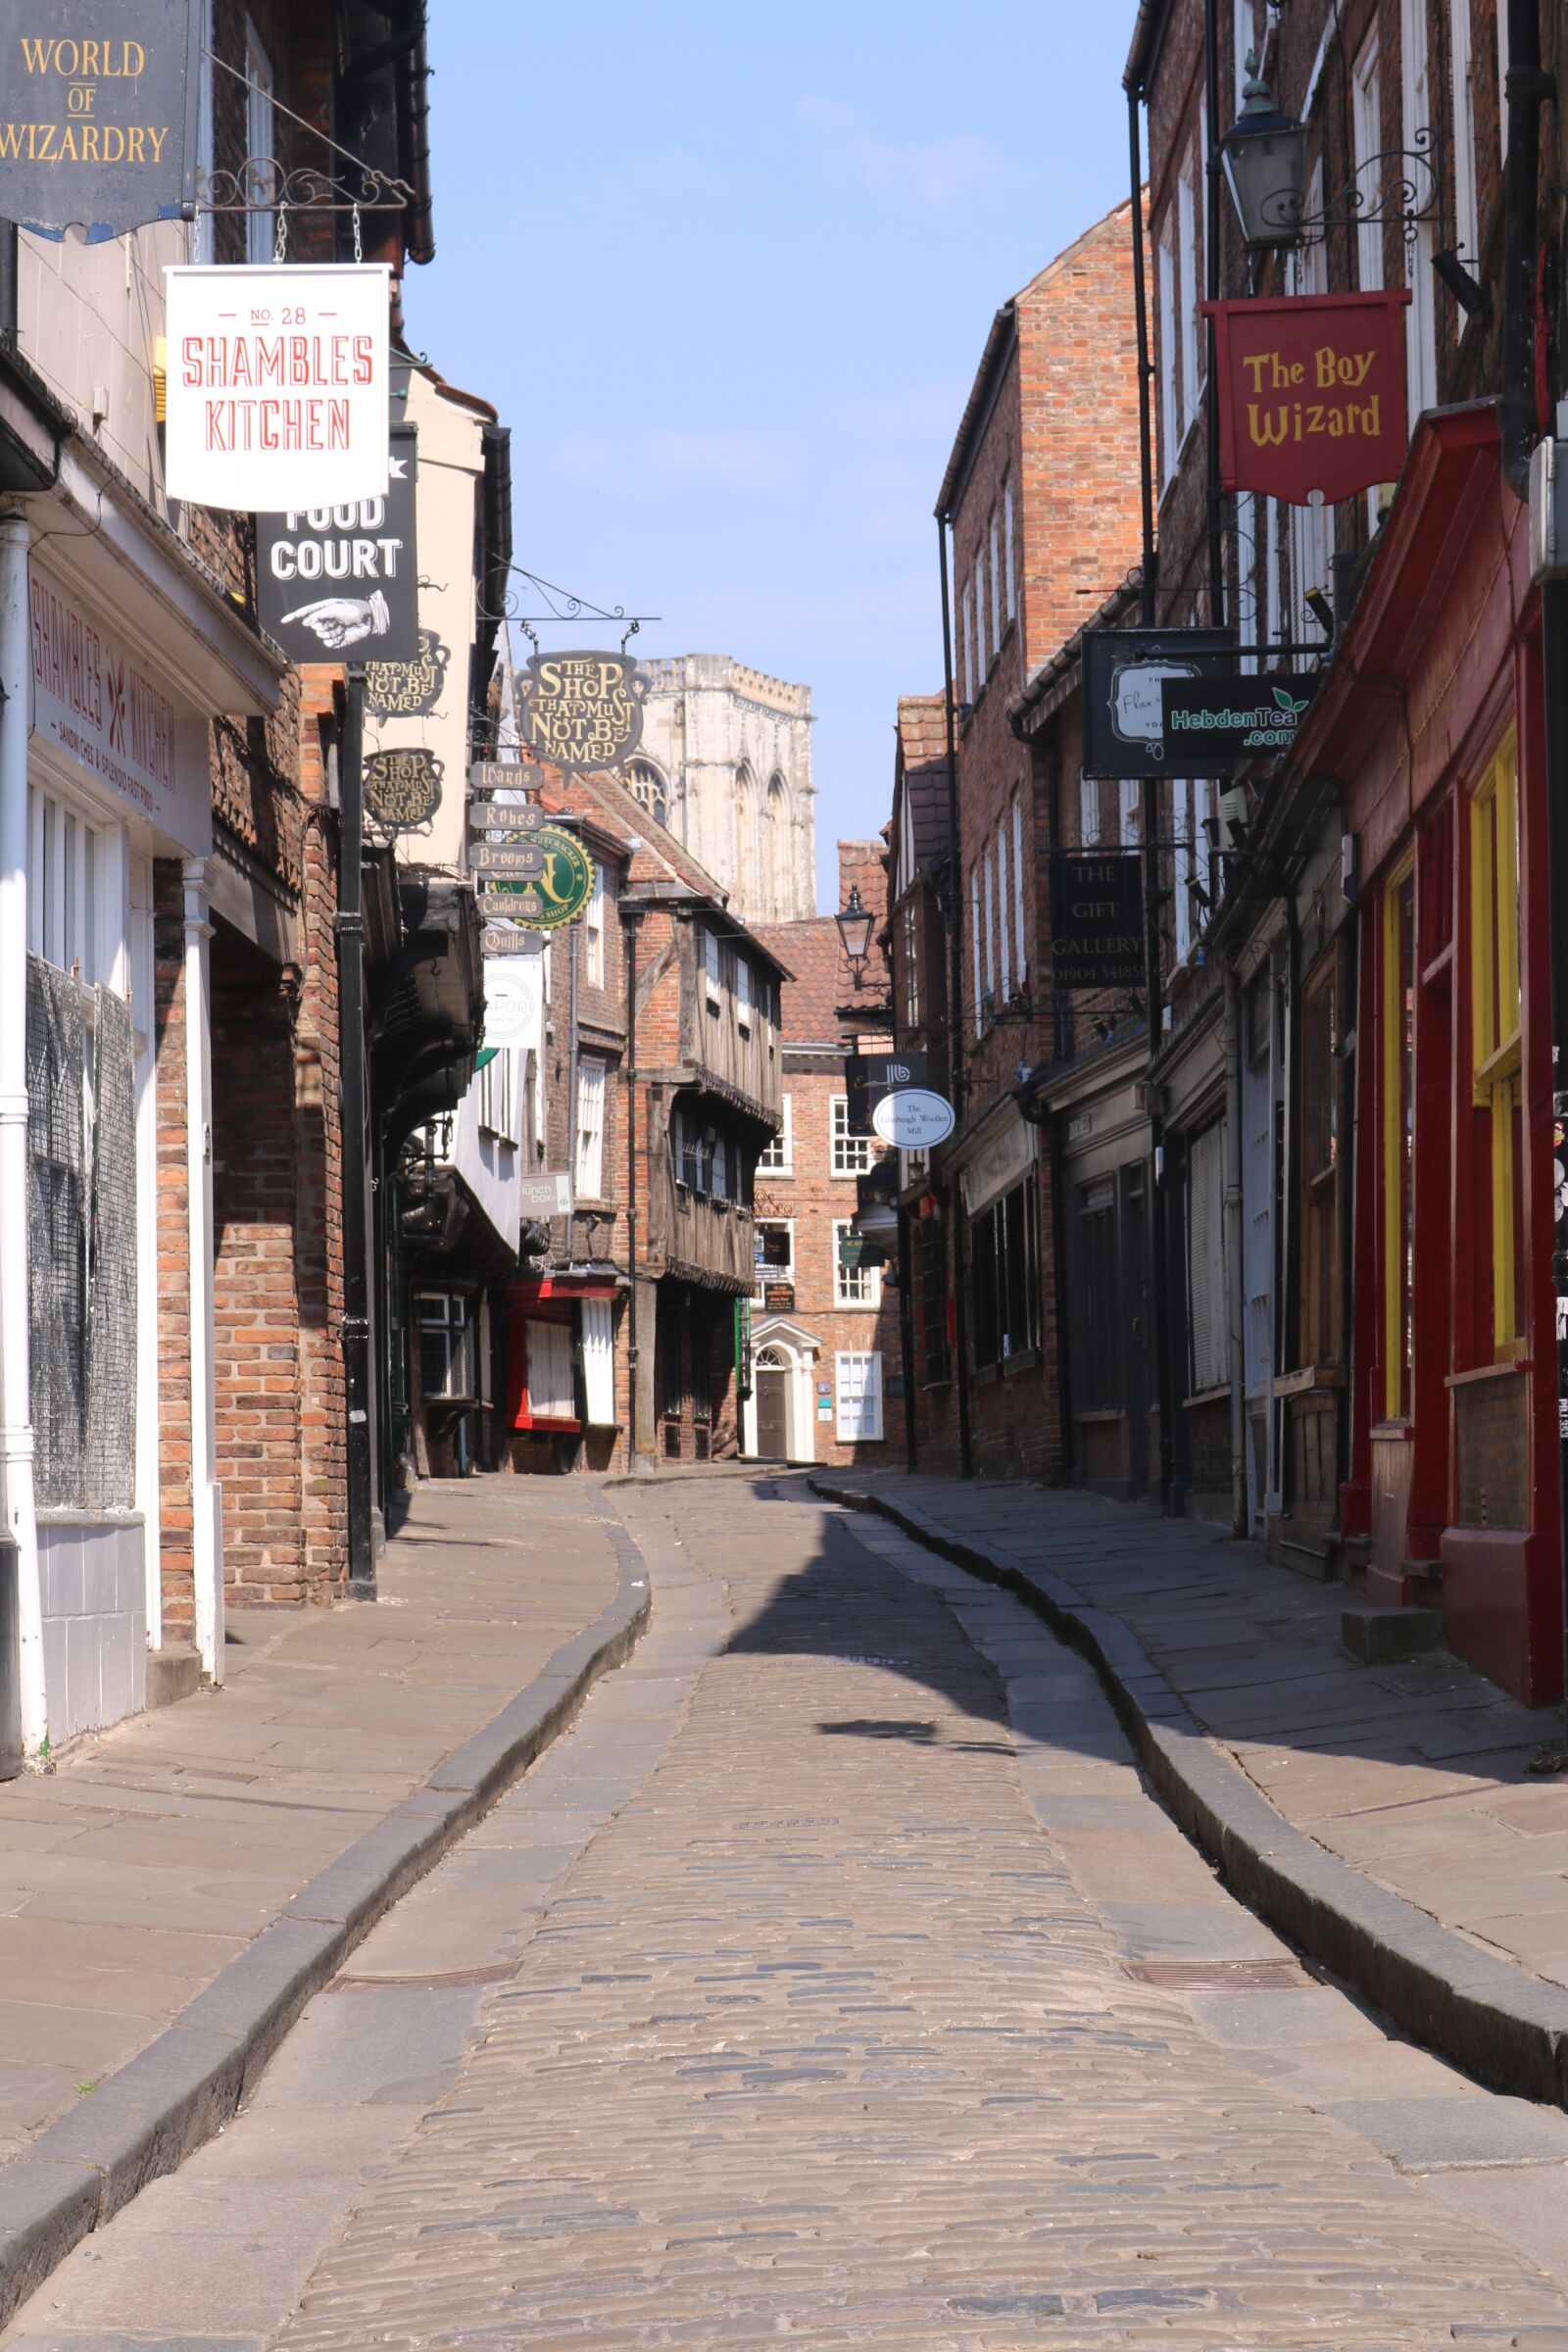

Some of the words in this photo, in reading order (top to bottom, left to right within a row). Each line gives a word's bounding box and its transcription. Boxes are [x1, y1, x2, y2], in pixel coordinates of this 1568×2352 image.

[21, 38, 145, 76] WORLD
[68, 87, 97, 112] OF
[0, 123, 170, 163] WIZARDRY
[281, 308, 306, 325] 28
[182, 336, 372, 387] SHAMBLES
[1243, 352, 1305, 393] The
[1314, 346, 1376, 387] Boy
[205, 399, 350, 451] KITCHEN
[1247, 394, 1381, 447] Wizard
[270, 538, 403, 580] COURT
[561, 658, 599, 678] THE
[31, 577, 103, 732] SHAMBLES
[128, 666, 176, 796] KITCHEN
[538, 662, 623, 699] SHOP
[368, 692, 422, 711] NAMED
[529, 699, 586, 717] THAT
[530, 712, 587, 745] NOT
[588, 718, 629, 743] BE
[1171, 708, 1298, 730] HebdenTea
[545, 741, 615, 763] NAMED
[482, 764, 530, 785] Wands
[486, 806, 536, 826] Robes
[479, 847, 533, 867] Brooms
[1072, 865, 1116, 883] THE
[482, 896, 537, 914] Cauldrons
[546, 904, 569, 918] SHOP
[1073, 901, 1120, 918] GIFT
[485, 931, 525, 951] Quills
[1052, 936, 1144, 956] GALLERY
[1053, 966, 1098, 980] 01904
